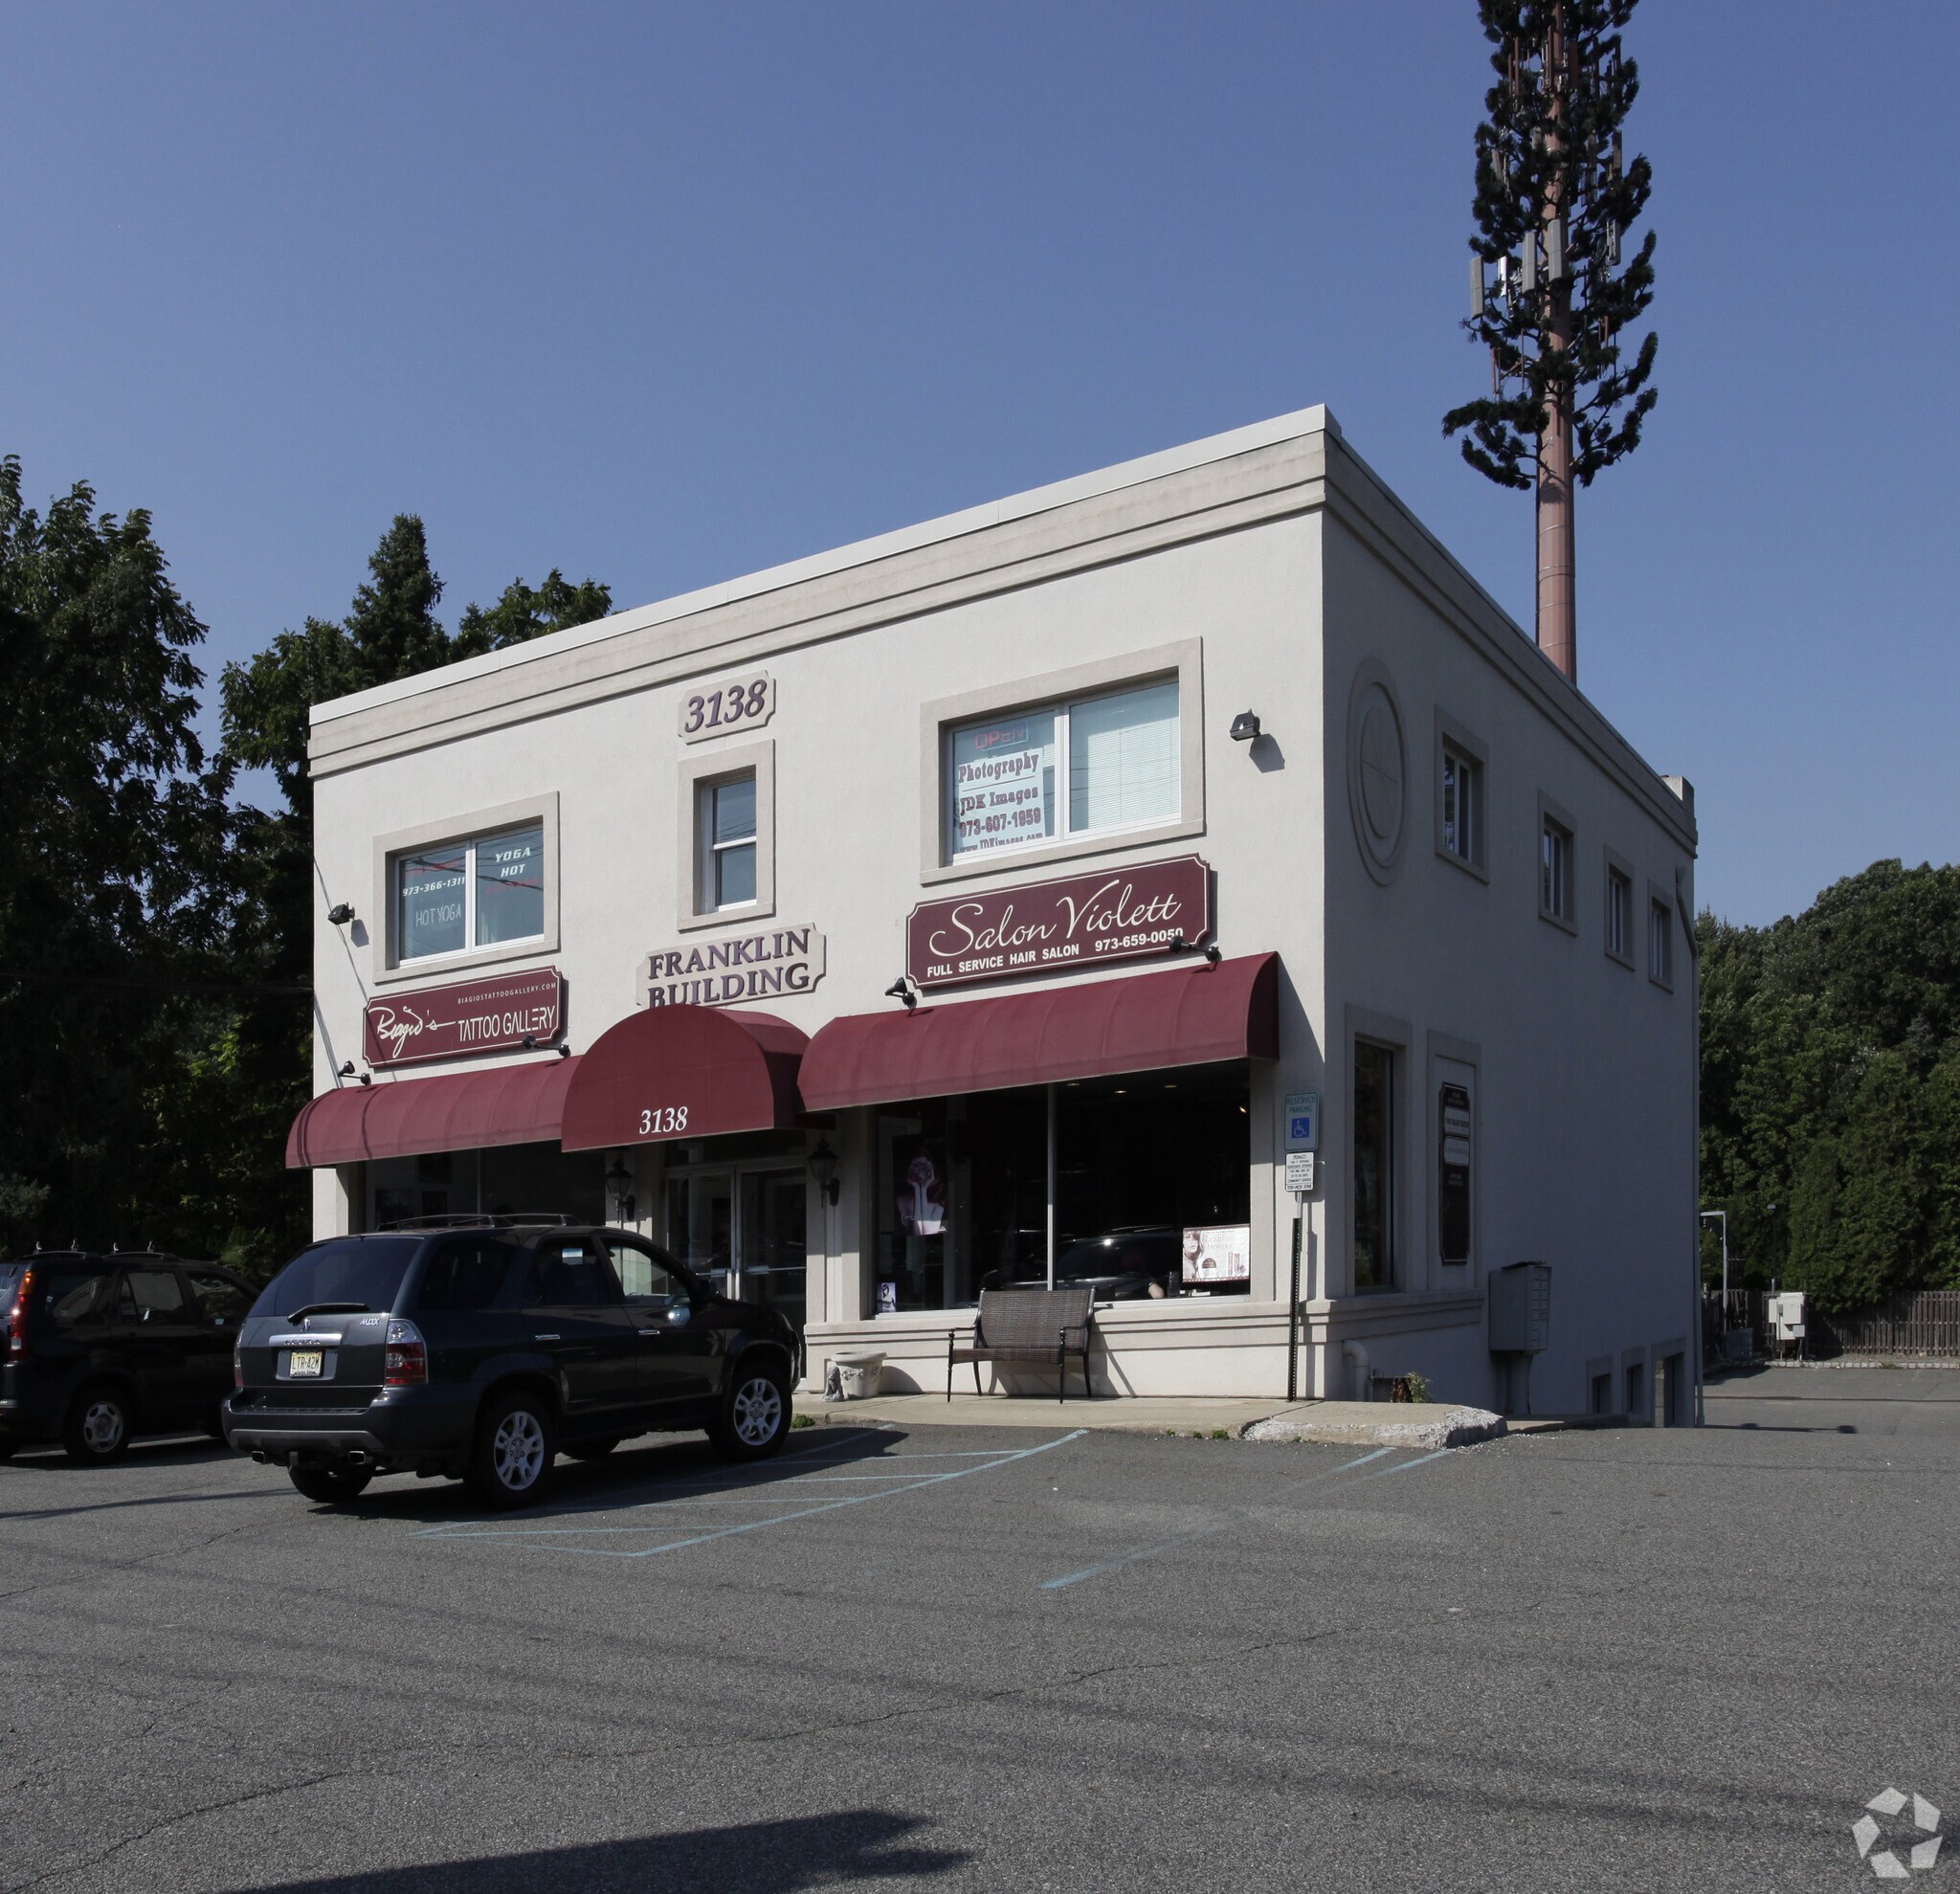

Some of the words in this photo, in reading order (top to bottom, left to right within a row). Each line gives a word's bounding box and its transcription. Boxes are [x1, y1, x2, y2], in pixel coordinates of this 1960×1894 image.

[684, 679, 768, 733] 3138
[959, 752, 1039, 783] Photography
[960, 793, 986, 816] JDK
[990, 787, 1038, 807] Images
[495, 847, 531, 862] YOGA
[501, 863, 525, 878] HOT
[403, 876, 465, 897] 973-366-1311
[415, 908, 436, 927] HOT
[437, 903, 461, 925] YOGA
[929, 902, 1057, 957] Salon
[1056, 879, 1182, 939] Violett
[648, 928, 811, 980] FRANKLIN
[926, 963, 953, 978] FULL
[958, 955, 1004, 973] SERVICE
[1009, 949, 1036, 965] HAIR
[1041, 944, 1080, 959] SALON
[457, 982, 556, 1004] BIAGIOSTATTOOGALLERY.COM
[648, 962, 811, 1009] BUILDING
[457, 1014, 501, 1042] TATTOO
[502, 1005, 556, 1036] GALLERY
[639, 1106, 688, 1135] 3138
[360, 1318, 380, 1326] MDX
